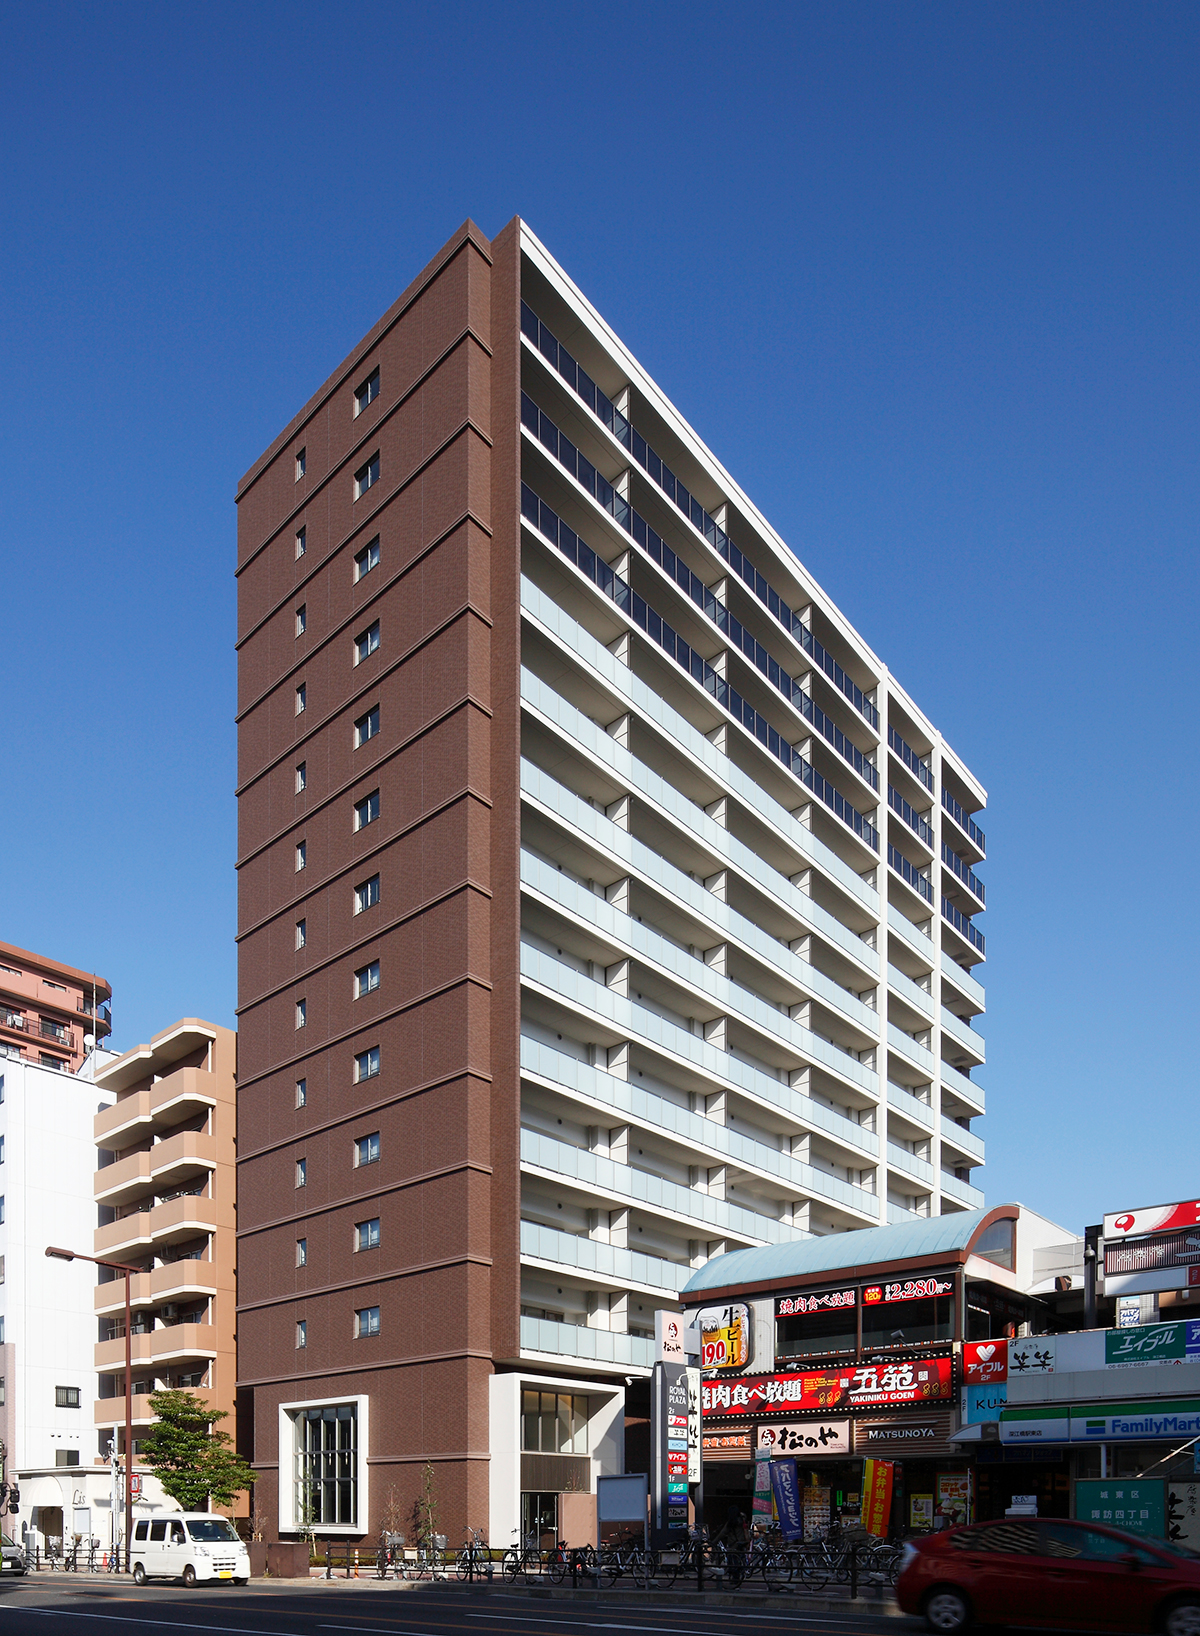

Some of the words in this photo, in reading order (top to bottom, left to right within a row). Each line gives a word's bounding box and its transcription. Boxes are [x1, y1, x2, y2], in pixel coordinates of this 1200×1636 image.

[779, 1290, 856, 1315] 焼肉食べ放題
[721, 1306, 740, 1365] 生ビール
[1112, 1325, 1179, 1355] エイブル
[967, 1361, 1004, 1374] アイフル
[848, 1363, 918, 1395] 五苑
[669, 1386, 686, 1395] ROYAL
[849, 1393, 888, 1403] YAKINIKU
[889, 1391, 915, 1400] GOEN
[668, 1395, 686, 1404] PLAZA
[1112, 1417, 1200, 1434] FamilyMart
[777, 1427, 839, 1450] 松のや
[868, 1428, 935, 1440] MATSUNOYA
[688, 1468, 697, 1477] 2F
[871, 1466, 887, 1535] お弁当・お惣菜
[1100, 1490, 1139, 1499] 城東区
[1091, 1510, 1149, 1519] 諏訪四丁目
